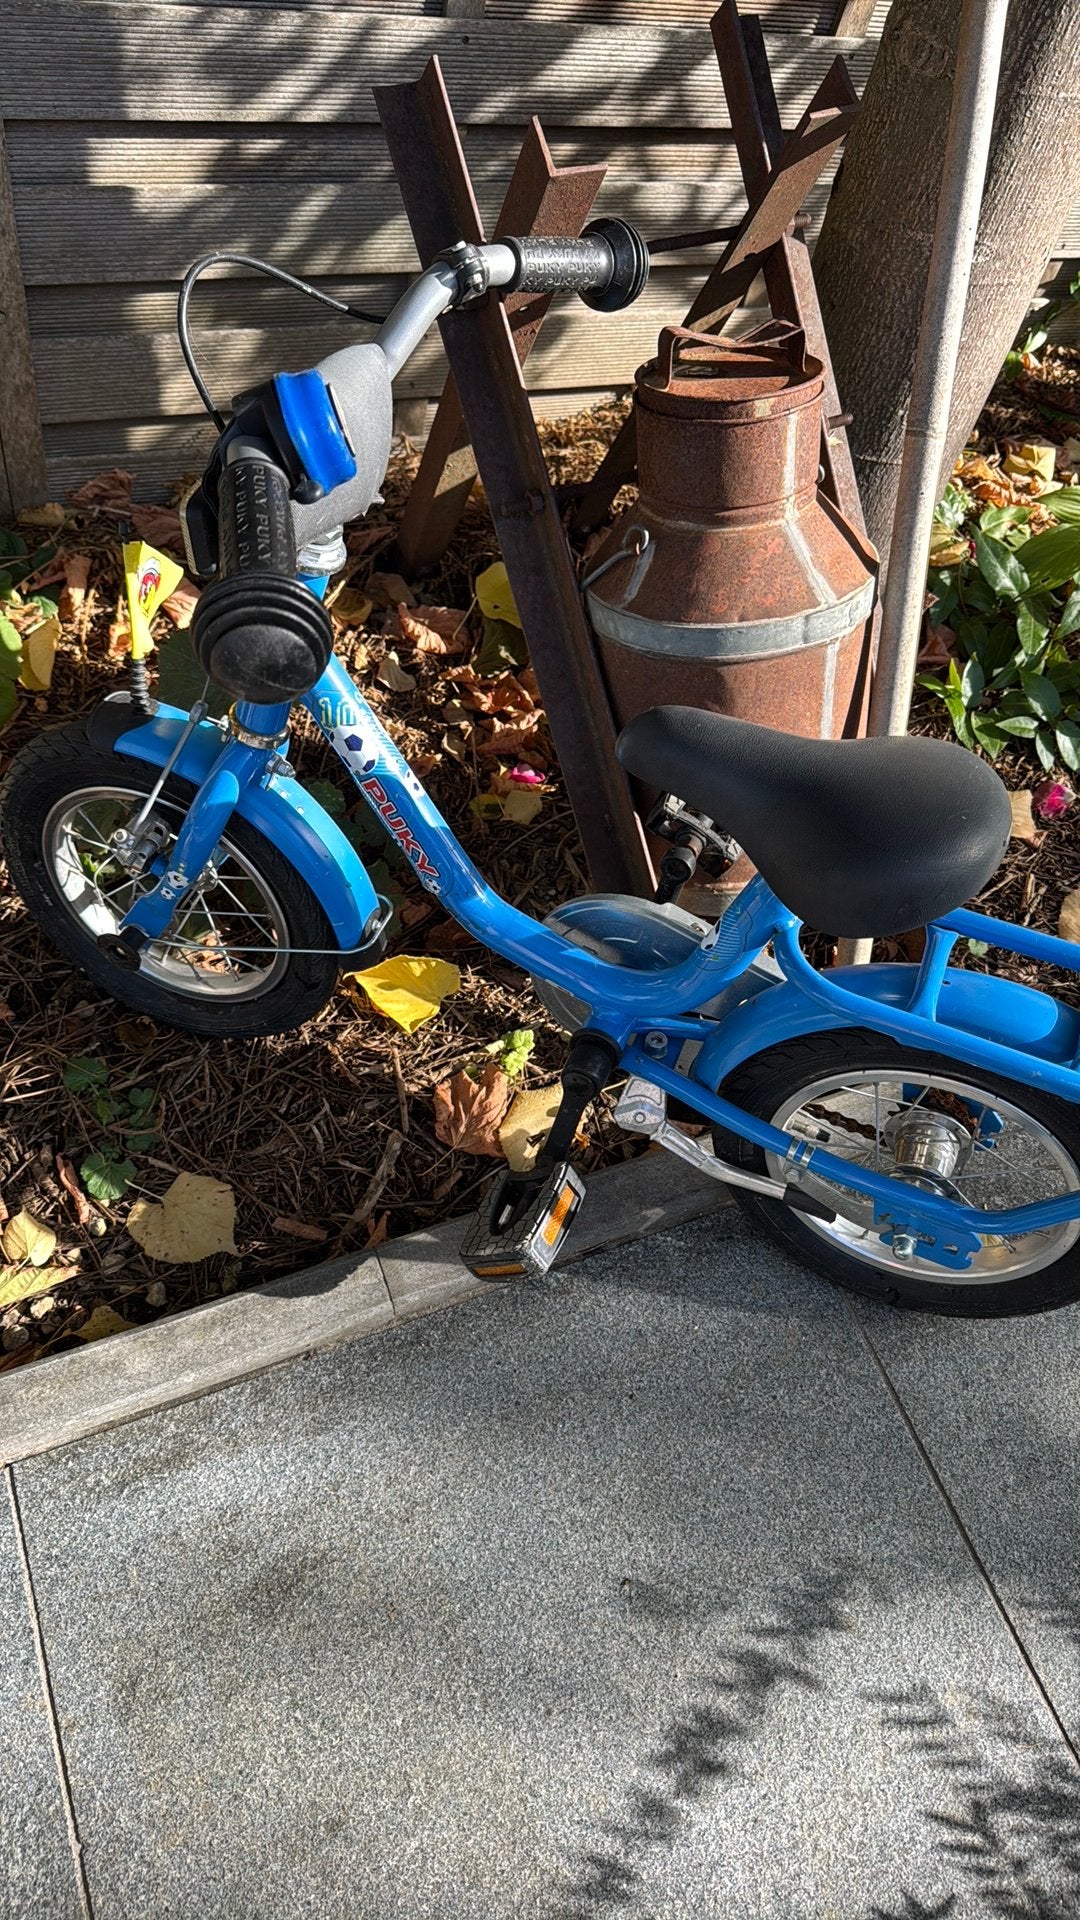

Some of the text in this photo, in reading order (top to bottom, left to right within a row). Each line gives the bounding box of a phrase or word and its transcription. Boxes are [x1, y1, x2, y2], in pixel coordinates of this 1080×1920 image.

[527, 262, 601, 274] PUKY PUKY
[544, 276, 580, 287] PUKY
[235, 490, 249, 535] PUKY
[252, 464, 273, 567] PUKY PUKY
[361, 777, 440, 878] PUKY
